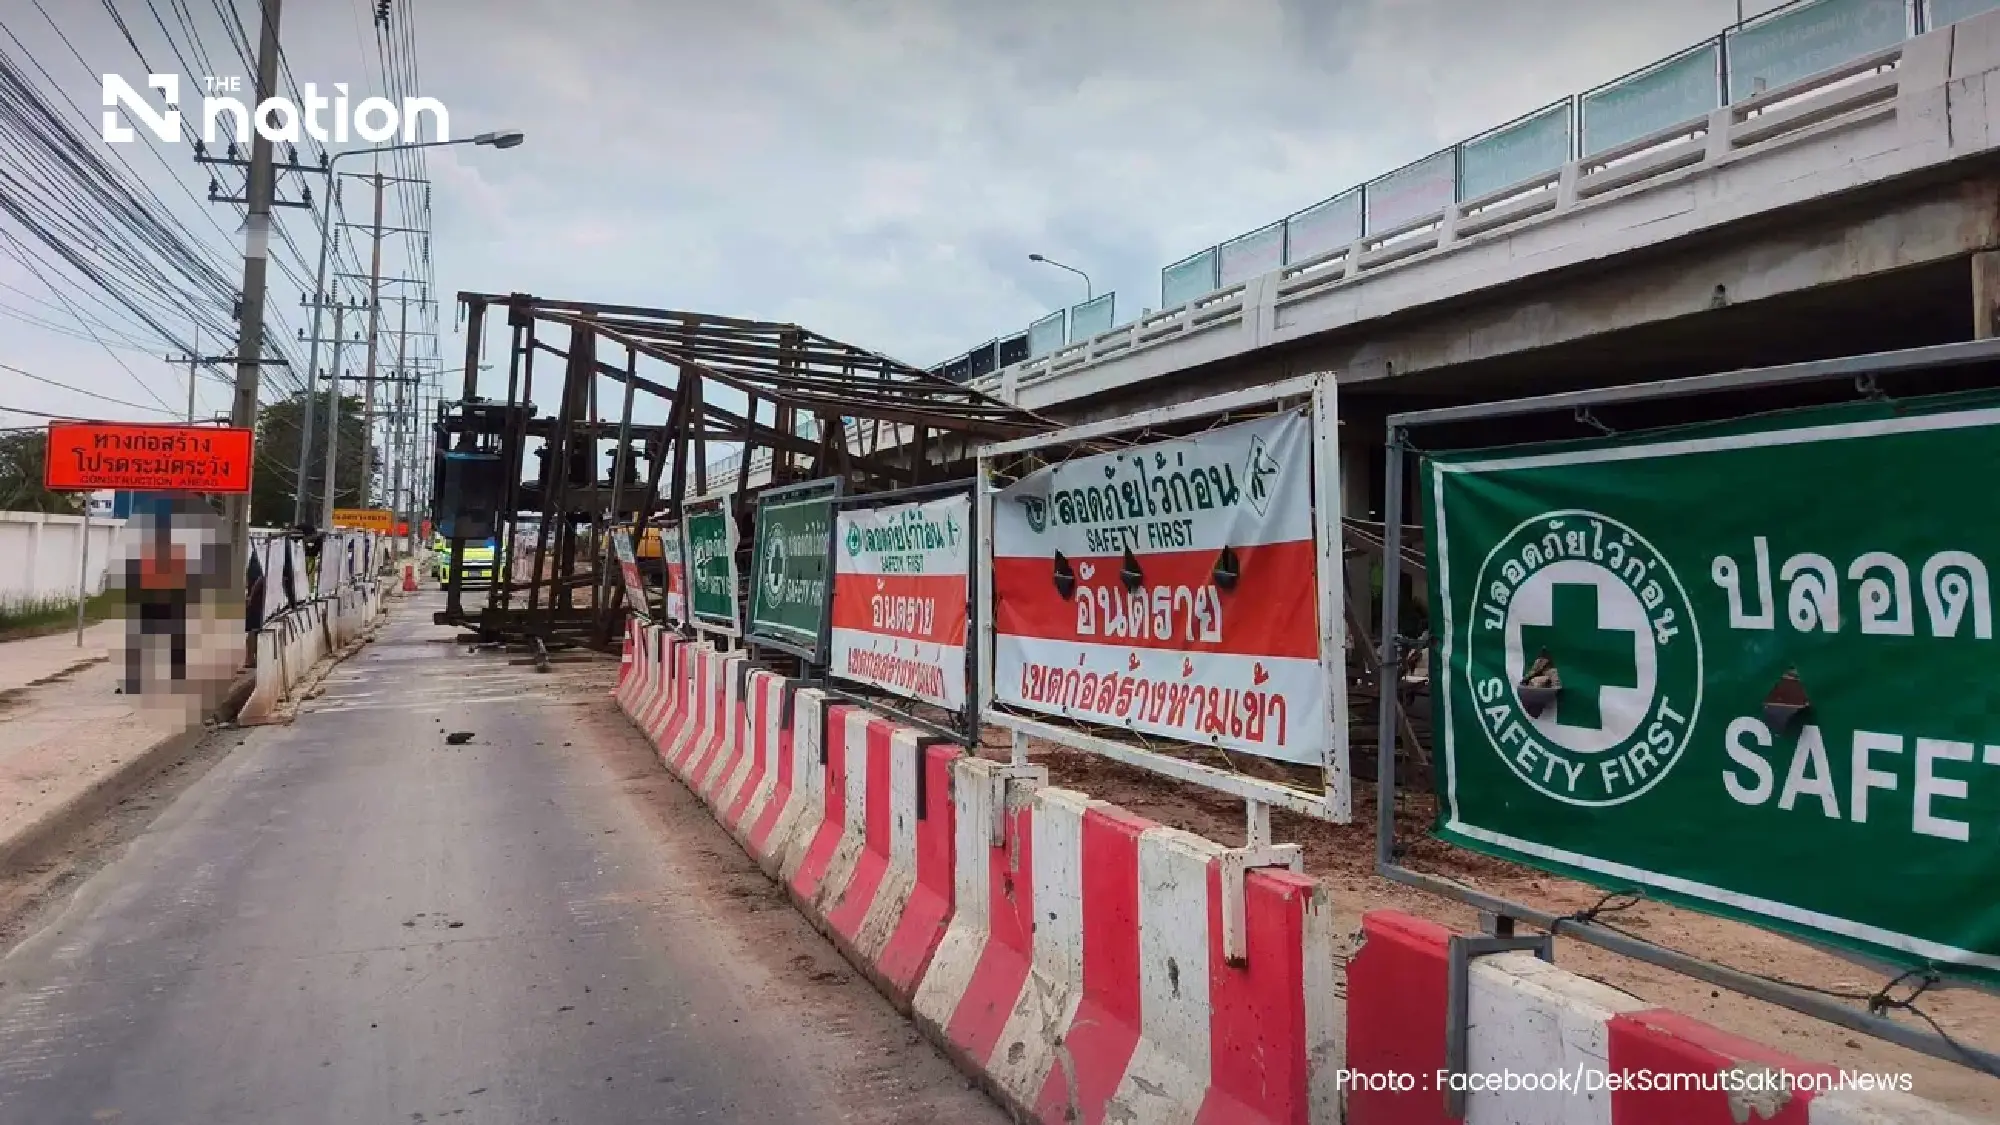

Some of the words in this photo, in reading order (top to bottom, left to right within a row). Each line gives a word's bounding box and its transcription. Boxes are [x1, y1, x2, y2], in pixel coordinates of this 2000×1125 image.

[93, 431, 211, 452] ทางก่อสร้าง
[1086, 525, 1140, 552] SAFETY
[1147, 519, 1193, 548] FIRST
[871, 578, 935, 635] อันตราย
[1076, 562, 1224, 644] อันตราย
[1482, 519, 1679, 645] ปลอดภัยไว้ก่อน
[1020, 652, 1289, 746] เขตก่อสร้างห้ามเข้า
[1477, 676, 1586, 792] SAFETY
[1600, 695, 1686, 794] FIRST
[1722, 716, 2000, 843] SAFE
